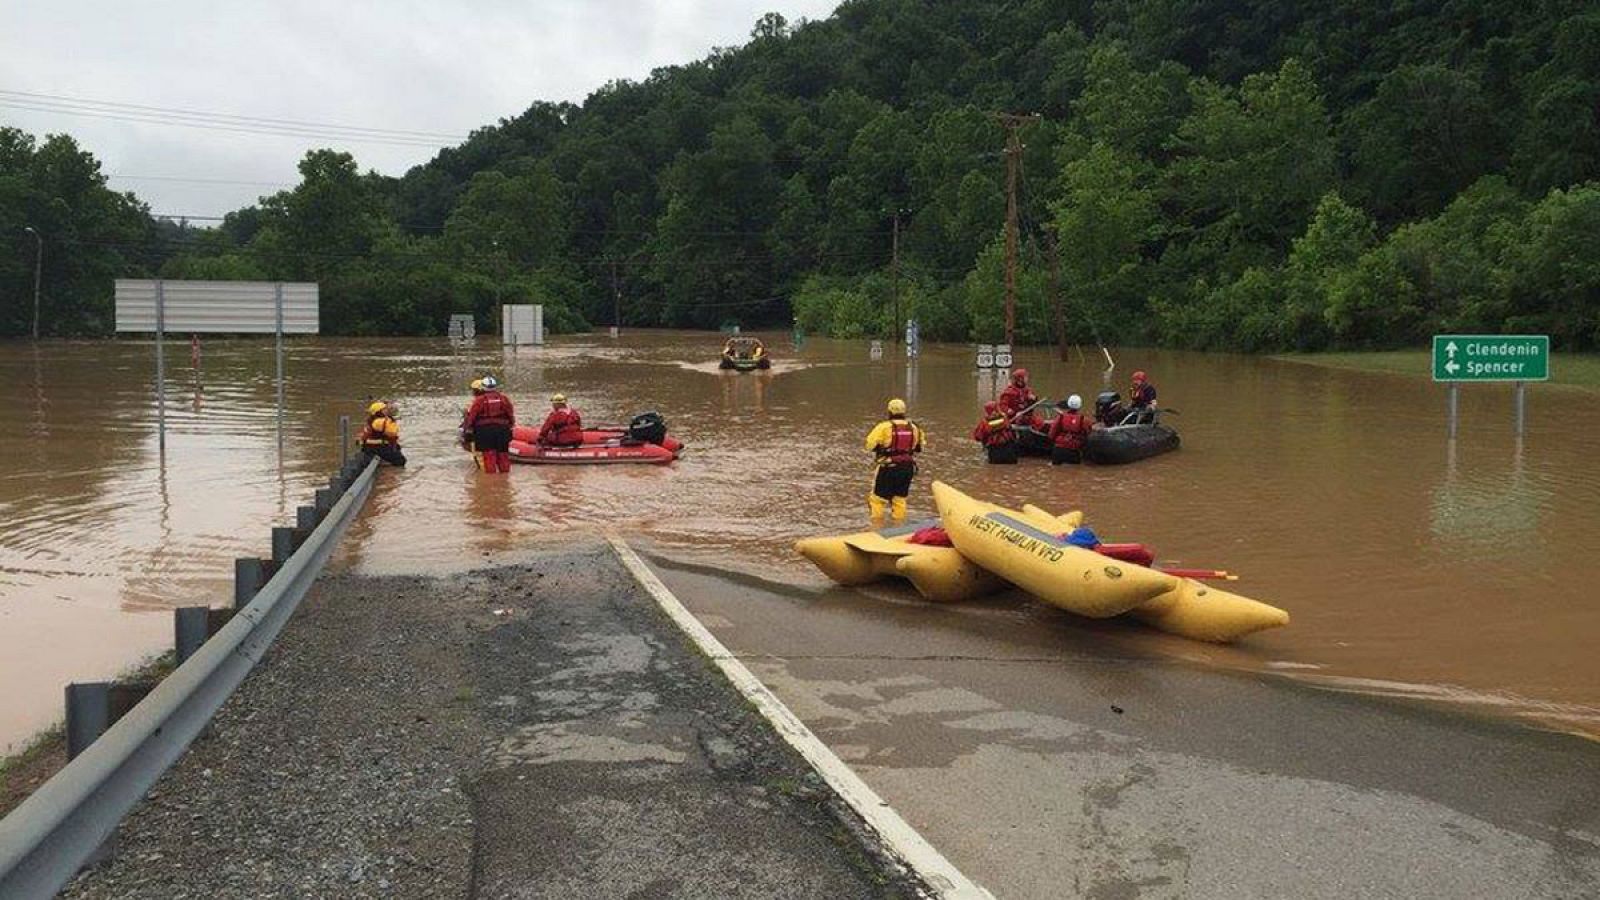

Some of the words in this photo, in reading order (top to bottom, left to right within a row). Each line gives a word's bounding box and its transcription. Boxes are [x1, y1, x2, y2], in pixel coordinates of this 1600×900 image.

[1466, 342, 1539, 356] Clendenin
[1466, 361, 1525, 376] Spencer
[969, 515, 1001, 534] WEST
[1039, 545, 1066, 563] VFD
